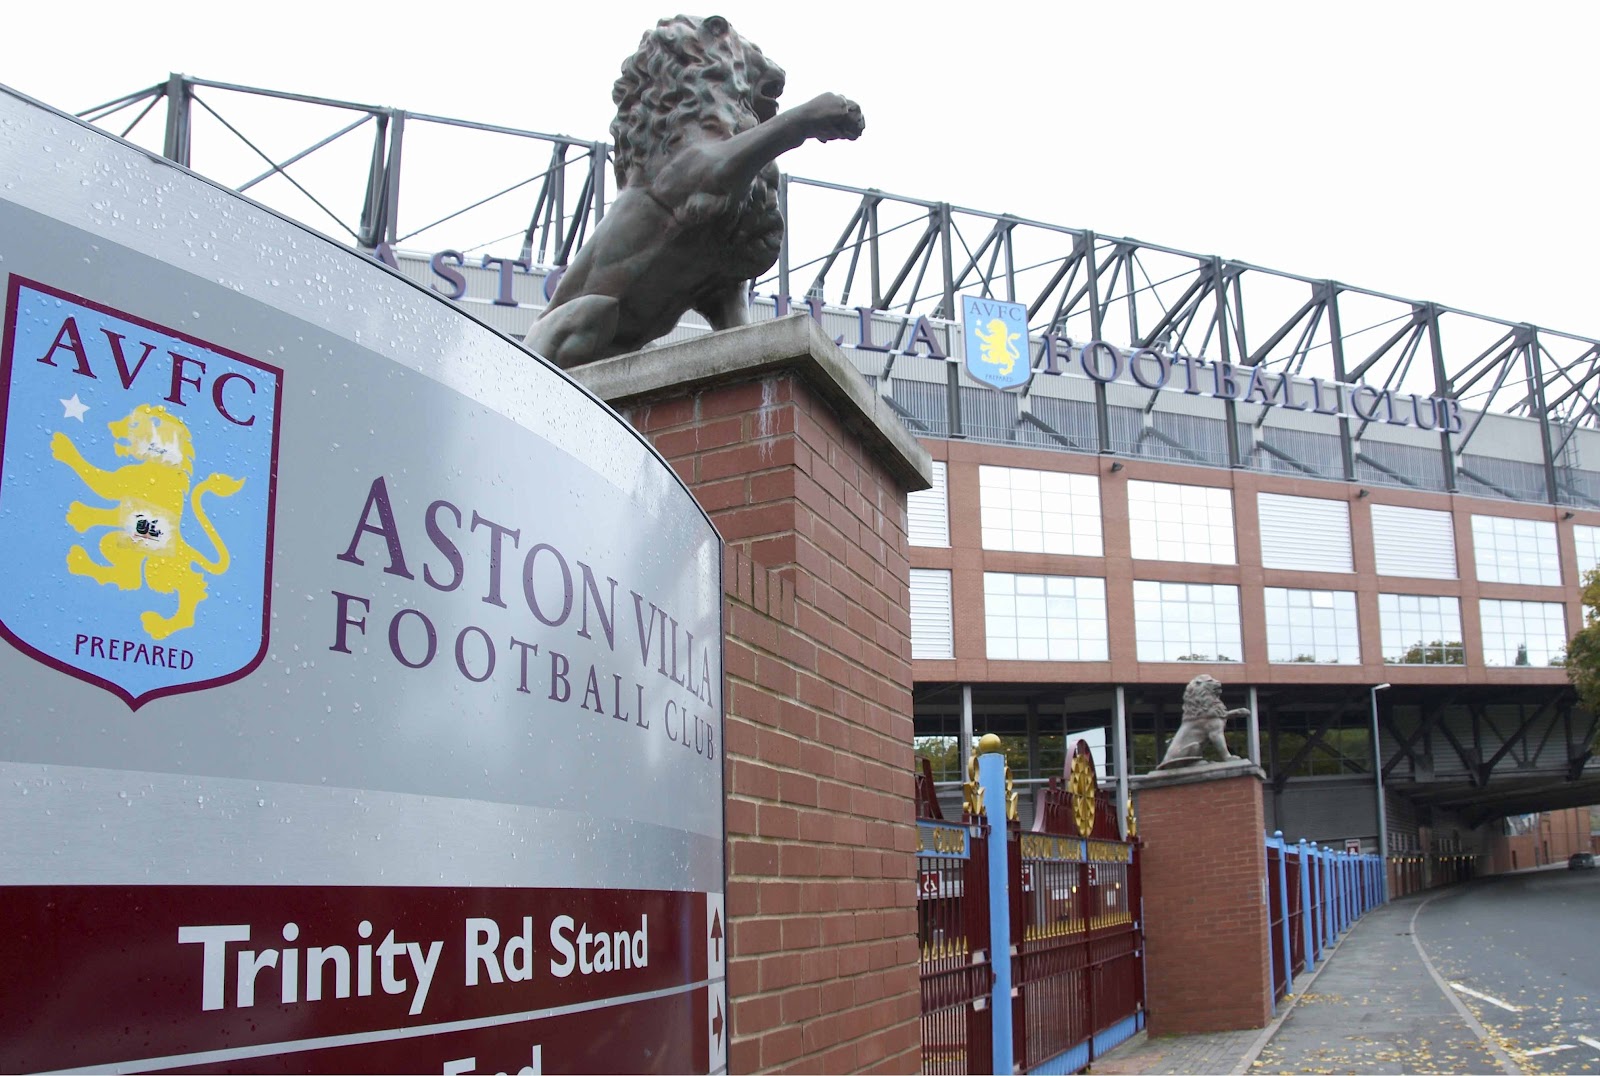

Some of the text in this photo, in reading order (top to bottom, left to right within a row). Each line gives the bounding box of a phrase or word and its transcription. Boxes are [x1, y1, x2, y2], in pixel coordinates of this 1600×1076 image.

[970, 301, 1022, 321] AVFC
[36, 316, 257, 426] AVFC
[1041, 333, 1338, 415] FOOTBALL
[1351, 385, 1463, 434] CLUB
[336, 475, 714, 709] ASTON VILLA
[74, 634, 195, 671] PREPARED
[328, 590, 715, 761] FOOTBALL CLUB
[177, 914, 649, 1015] Trinity Rd Stand
